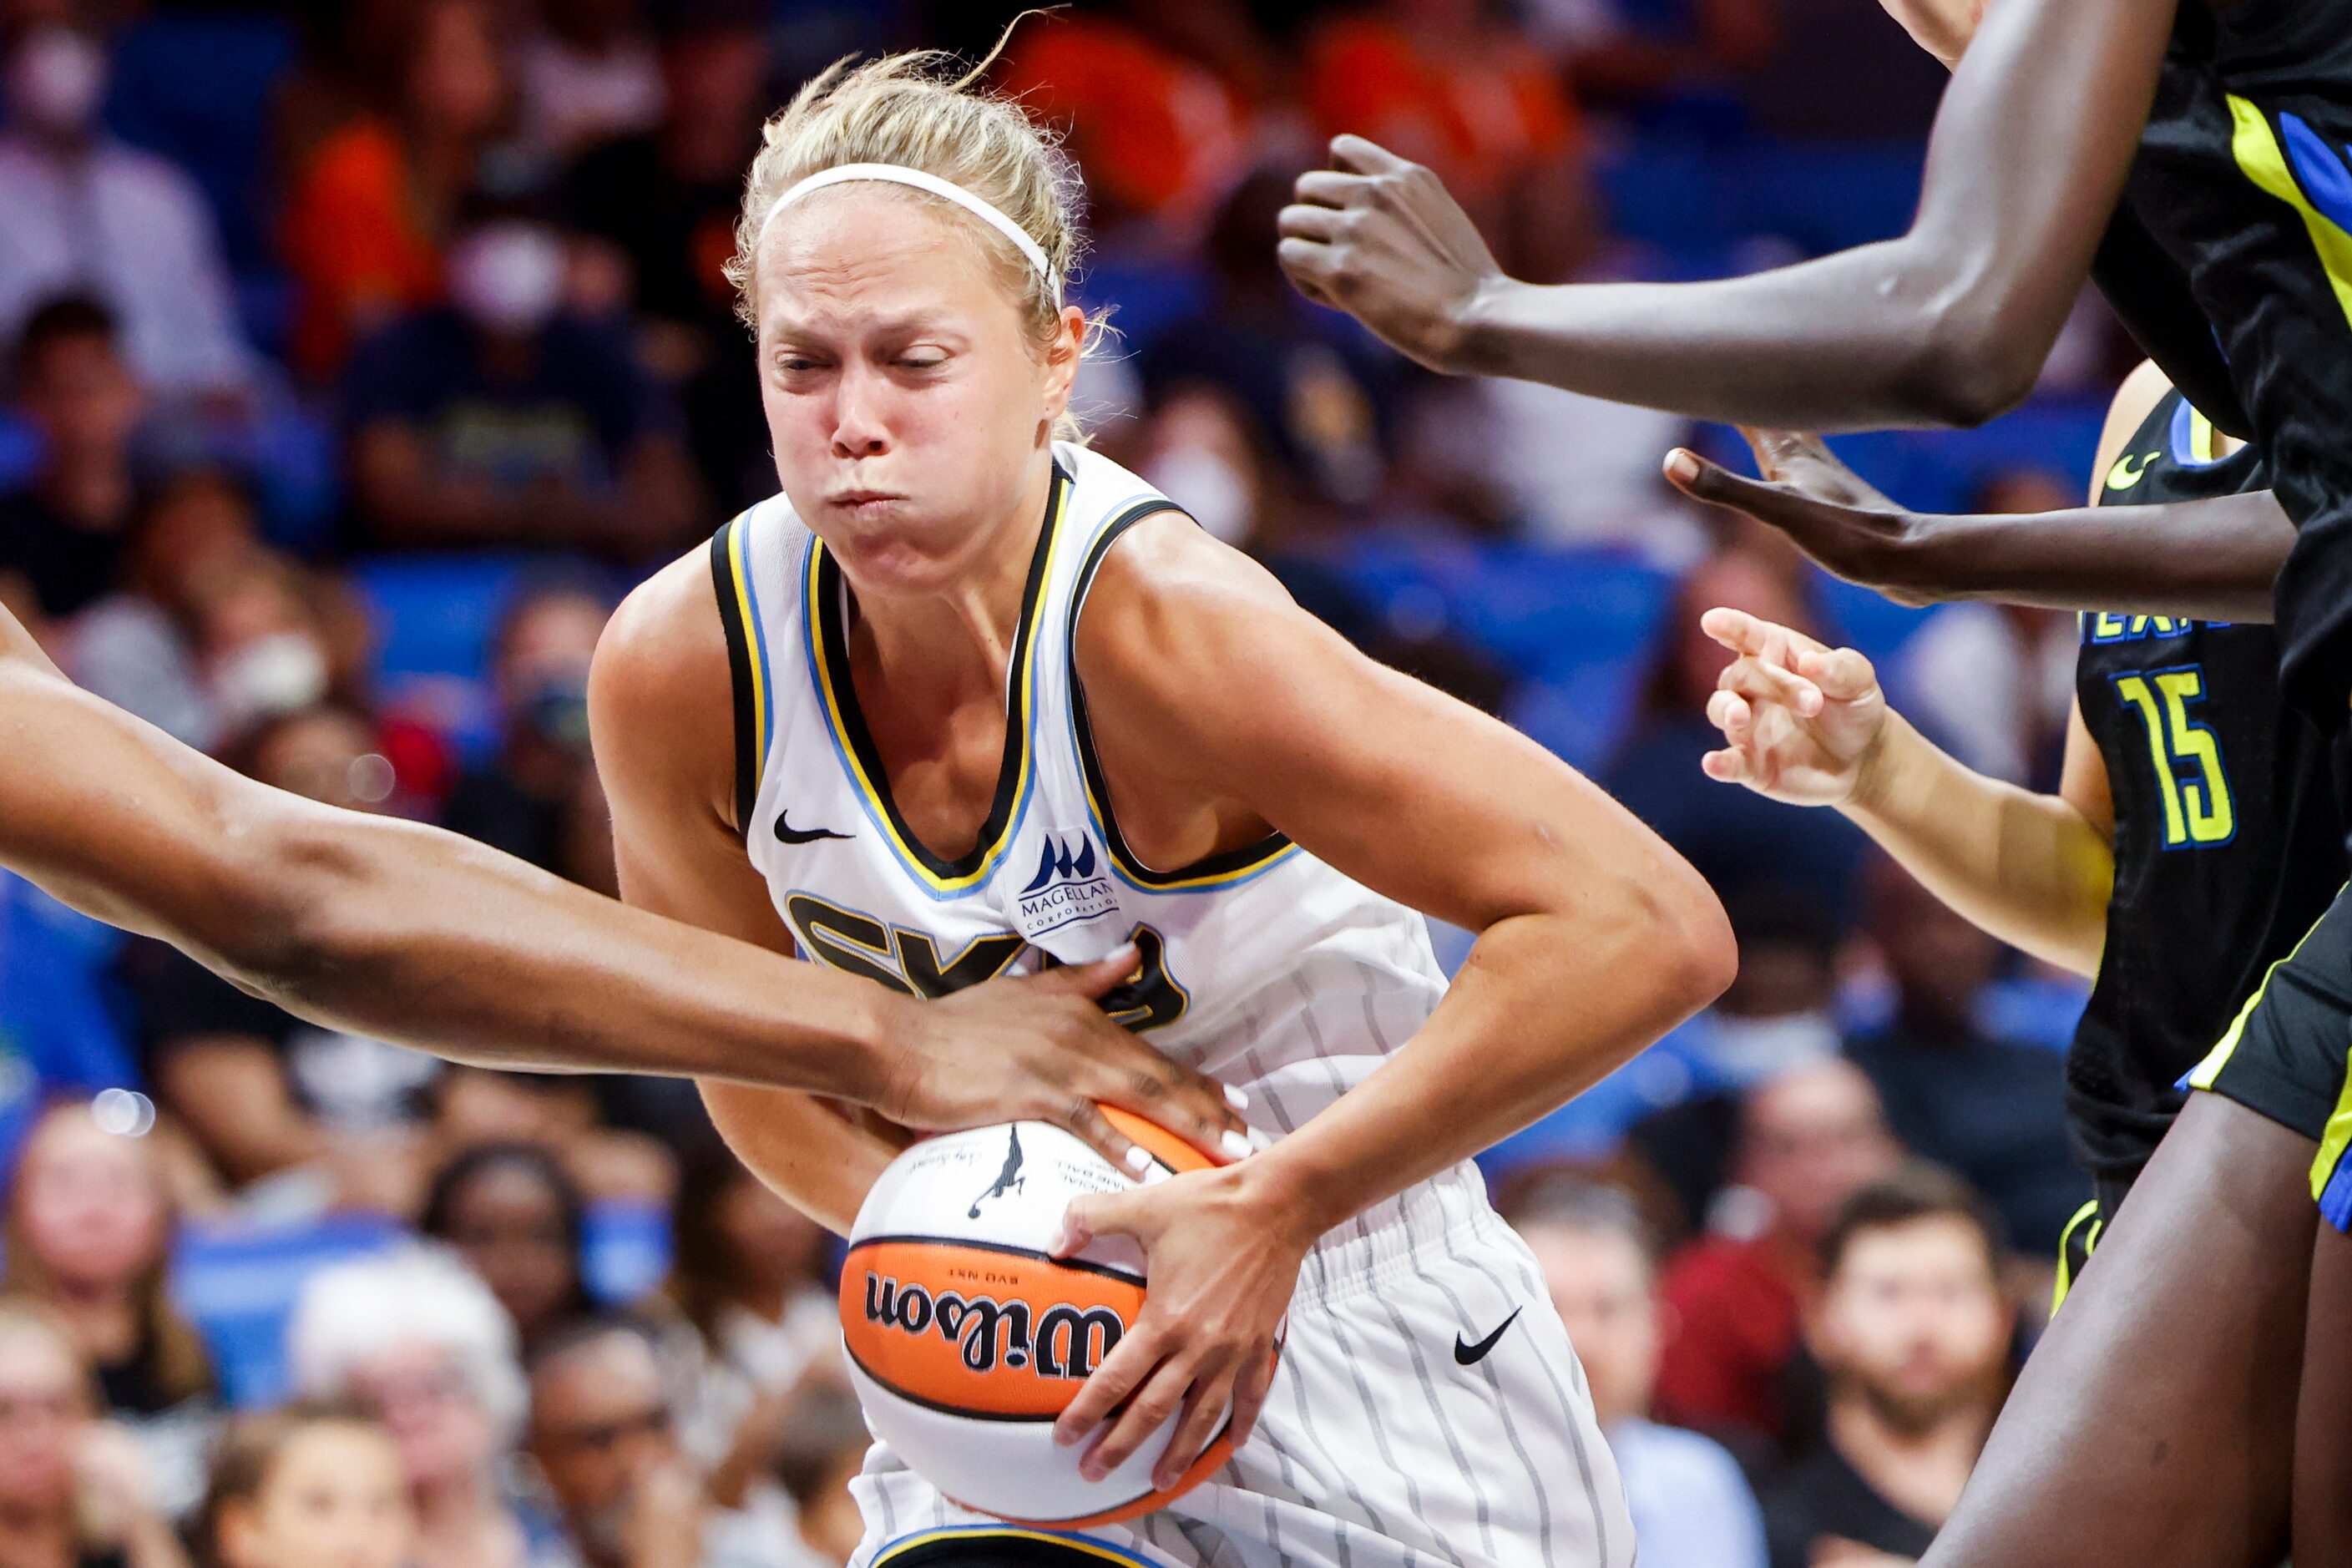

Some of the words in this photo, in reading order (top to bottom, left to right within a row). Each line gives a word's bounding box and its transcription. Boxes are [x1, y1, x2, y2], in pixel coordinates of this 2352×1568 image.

[2107, 663, 2238, 852] 15
[1021, 882, 1115, 918] MAGELLAN
[864, 1272, 1125, 1379] Wilson
